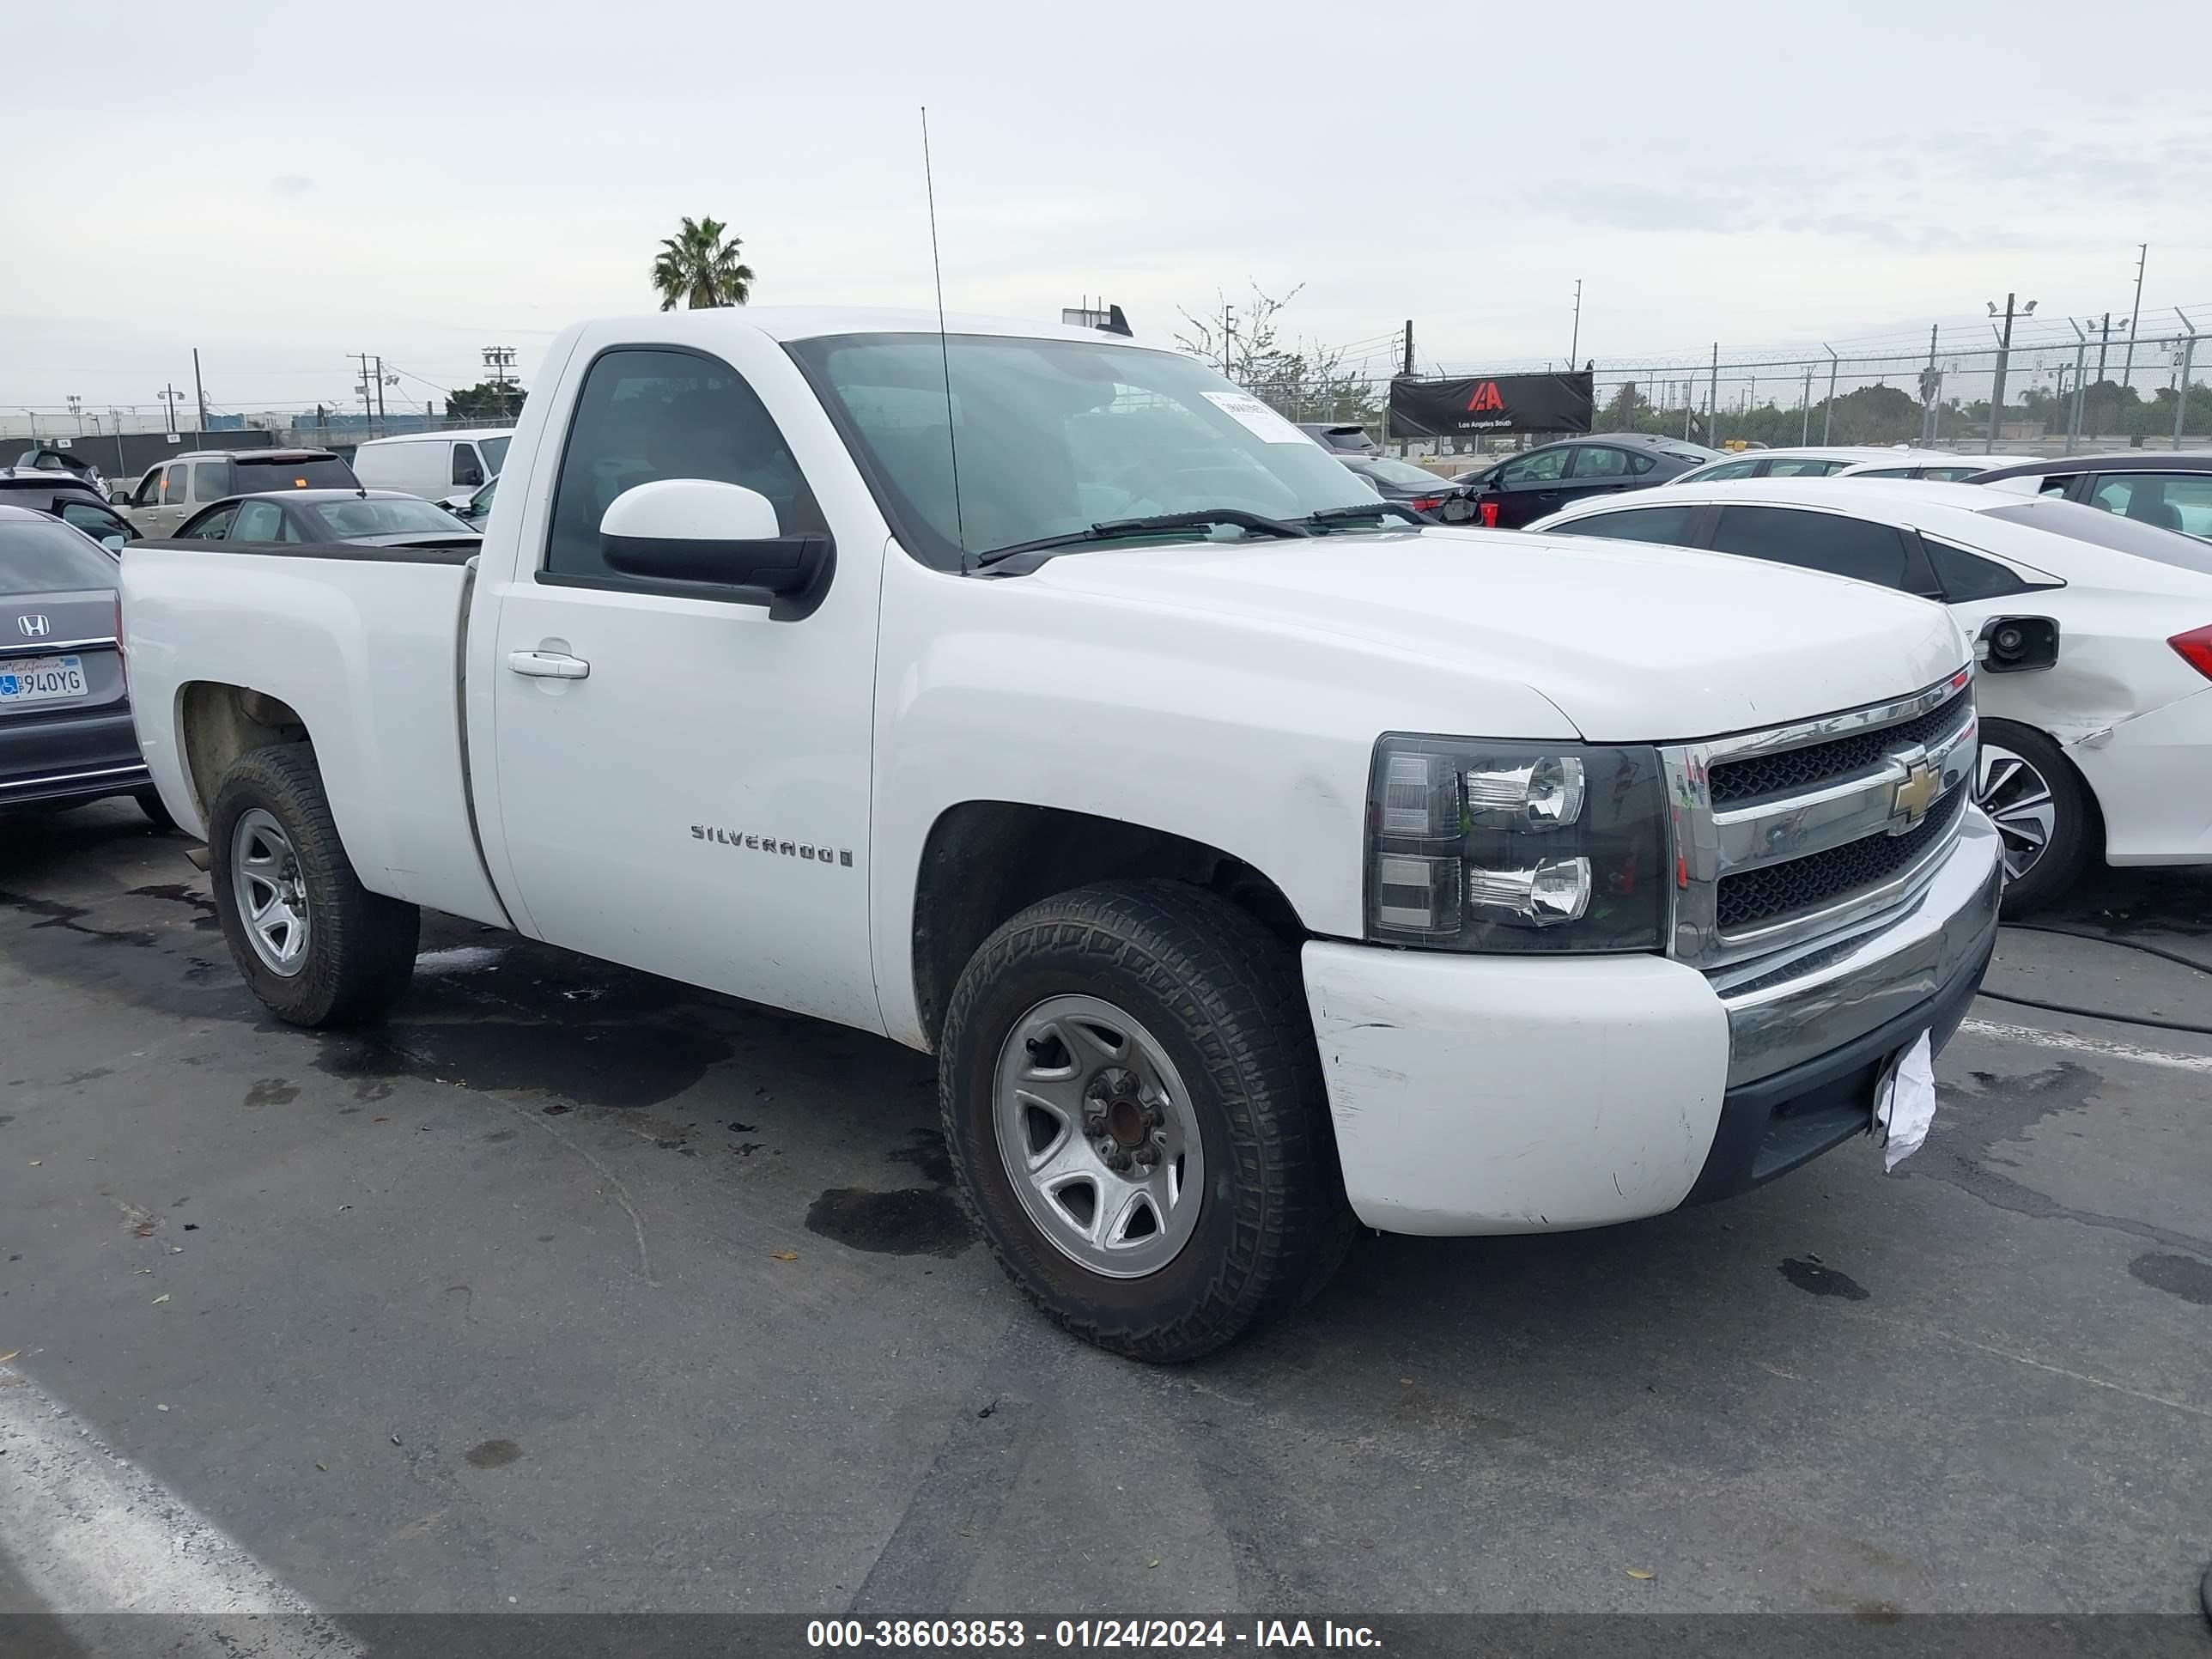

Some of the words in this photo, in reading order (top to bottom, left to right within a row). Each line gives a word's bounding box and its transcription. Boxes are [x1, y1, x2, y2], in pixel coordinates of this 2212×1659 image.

[2173, 352, 2184, 366] 20
[1471, 421, 1494, 429] Angeles
[12, 660, 66, 673] California
[25, 671, 81, 694] 940YG
[690, 824, 834, 863] SILVERADO
